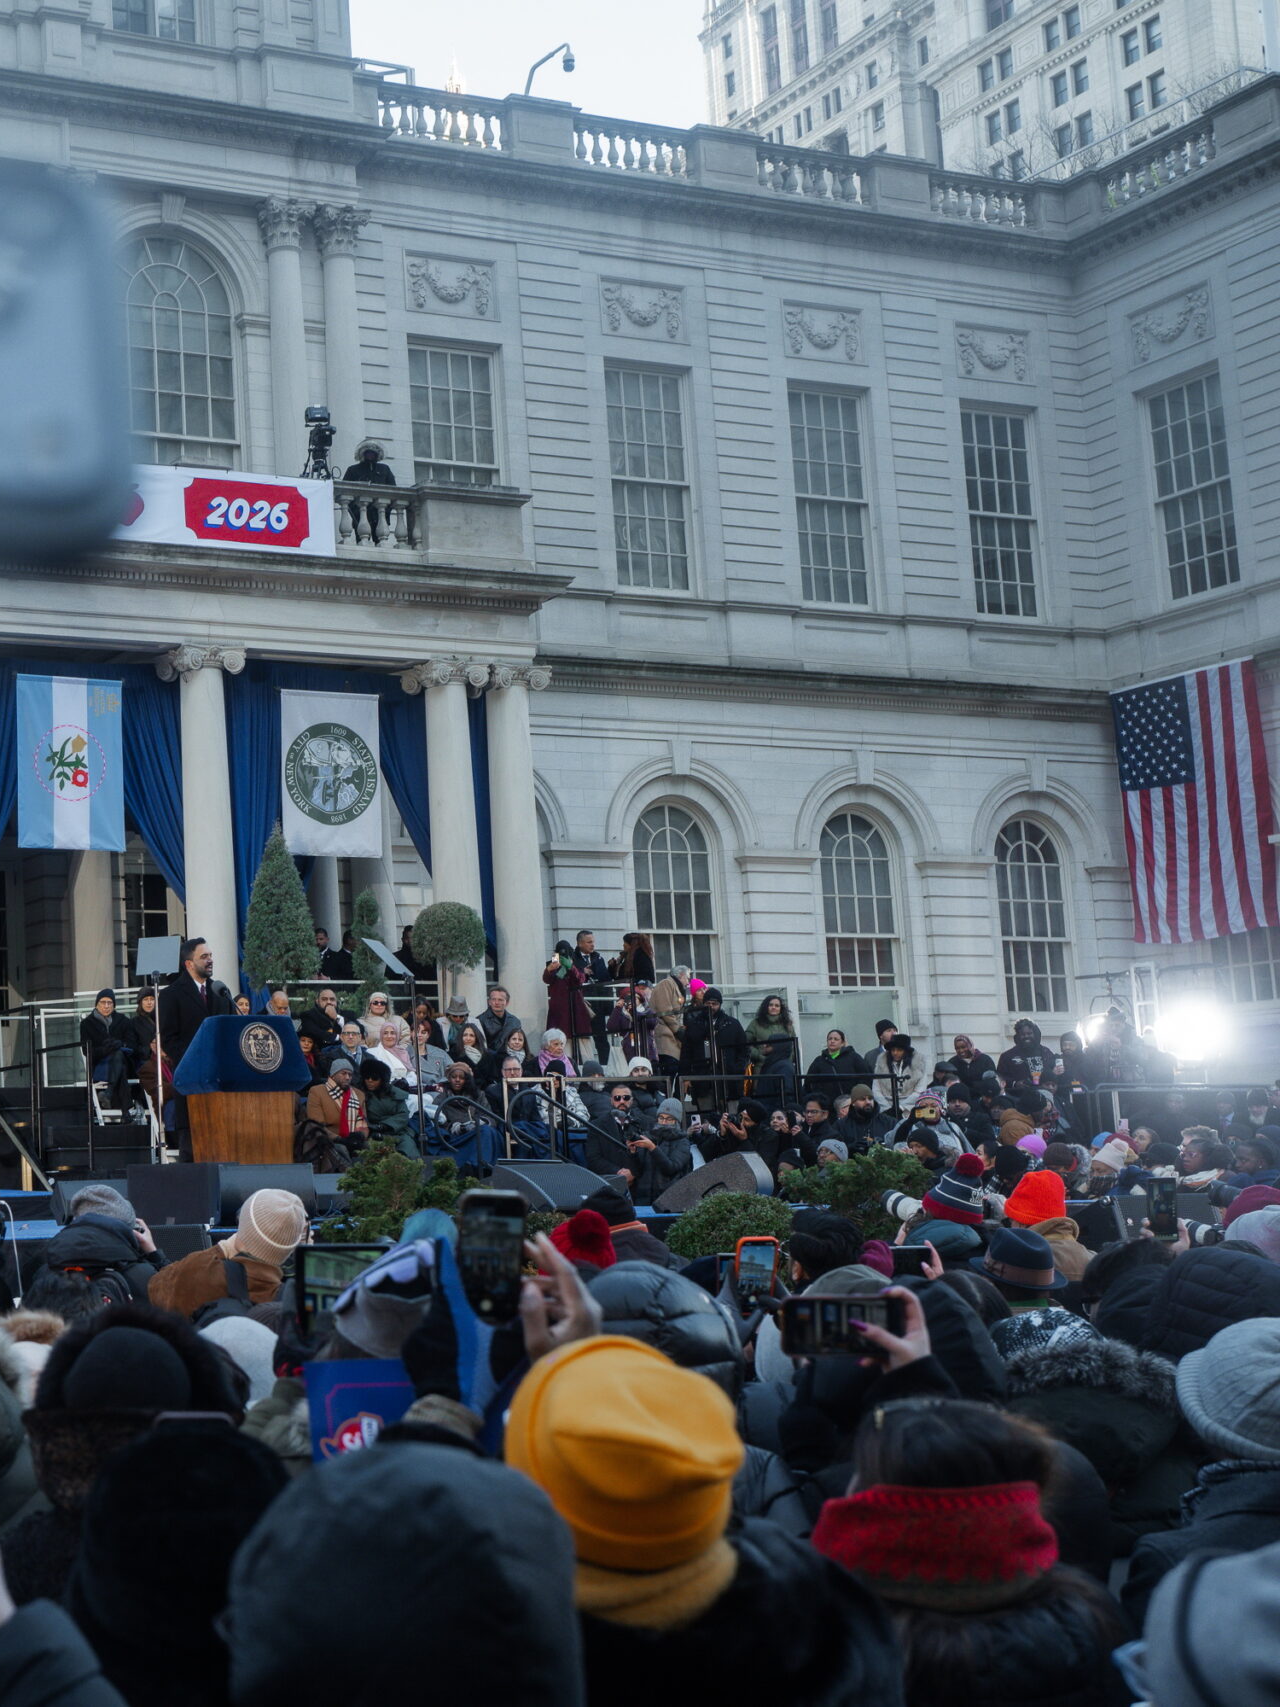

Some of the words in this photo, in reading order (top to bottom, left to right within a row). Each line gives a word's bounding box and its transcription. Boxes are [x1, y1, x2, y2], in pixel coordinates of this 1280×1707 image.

[204, 496, 289, 533] 2026
[293, 731, 311, 753] CITY
[330, 725, 347, 736] 1609
[352, 737, 376, 776] STATEN
[286, 761, 296, 786] NEW
[290, 787, 313, 813] YORK
[352, 777, 376, 815] ISLAND
[330, 813, 348, 824] 1898
